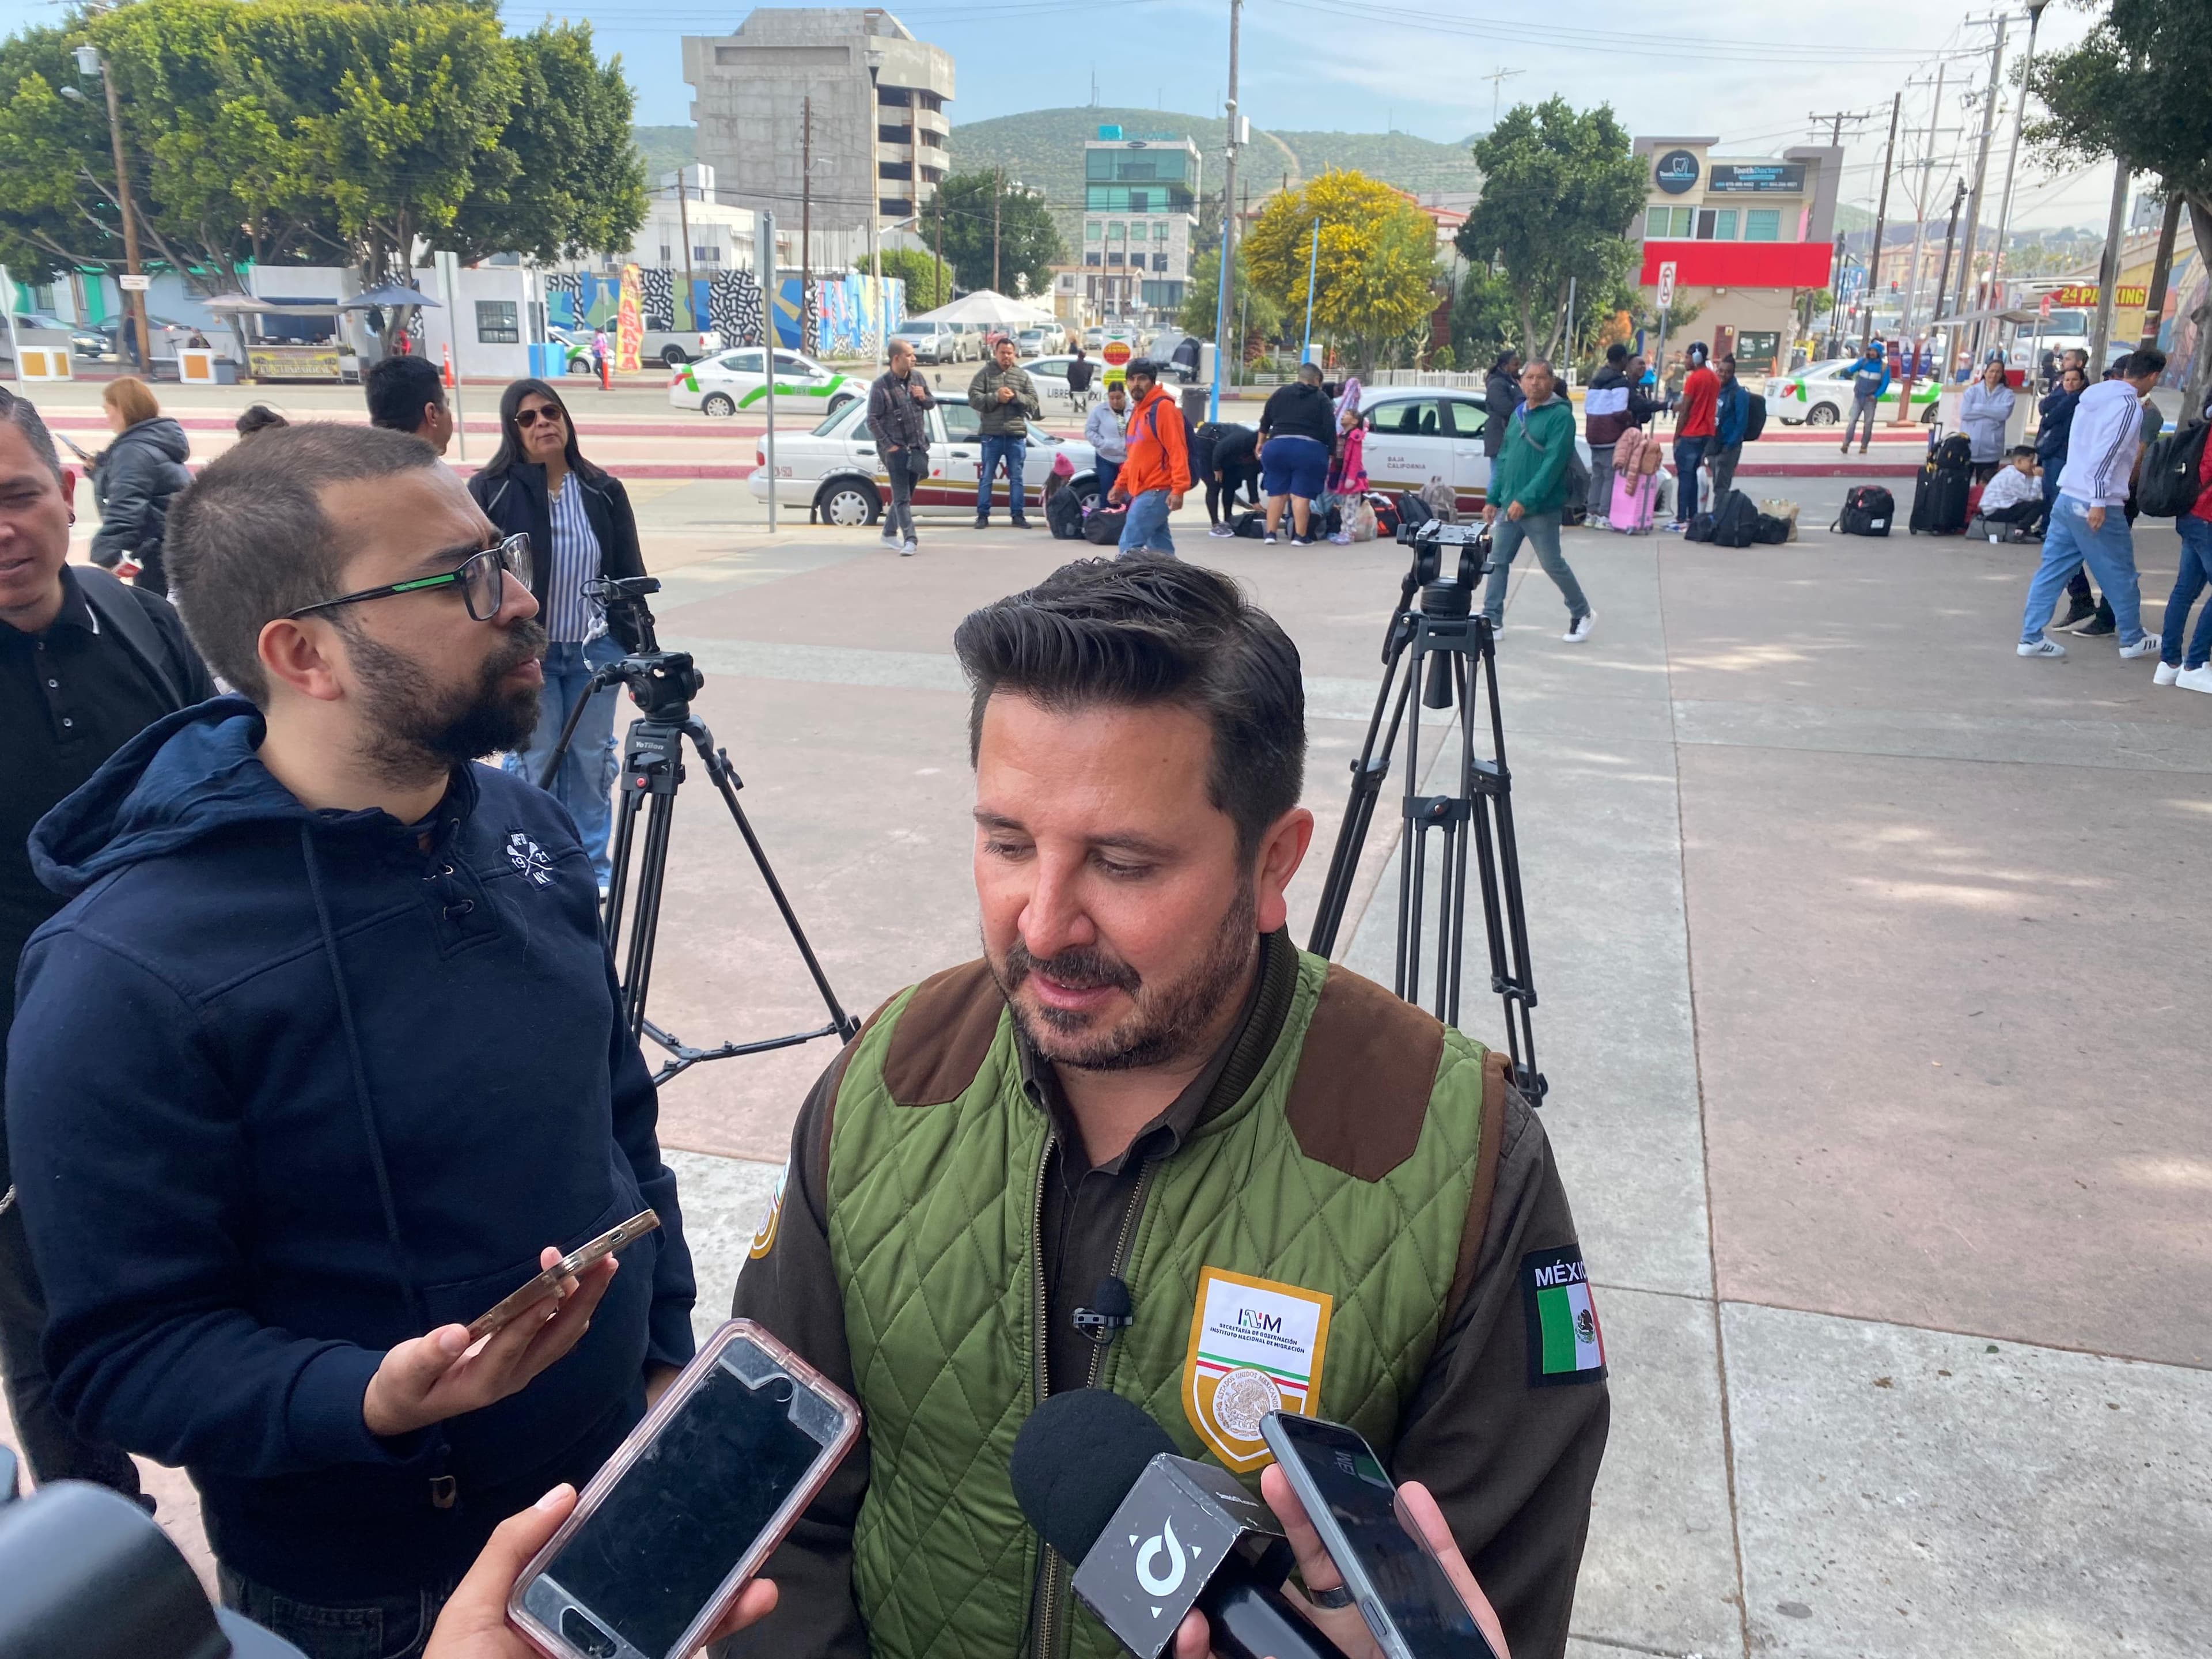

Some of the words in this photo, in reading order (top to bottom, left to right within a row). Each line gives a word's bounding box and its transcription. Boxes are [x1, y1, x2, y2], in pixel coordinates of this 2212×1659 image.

[2062, 287, 2077, 298] 24
[2080, 287, 2145, 304] PAKING
[1047, 388, 1069, 399] LIBRE
[1210, 1327, 1237, 1338] INSTITUTO
[1238, 1334, 1265, 1344] NACIONAL
[1274, 1342, 1305, 1354] MIGRACIÓN
[1219, 1323, 1251, 1335] SECRETARÍA
[1259, 1332, 1298, 1346] GOBERNACIÓN
[1217, 1376, 1235, 1400] ESTADOS
[1235, 1371, 1257, 1379] UNIDOS
[1258, 1376, 1279, 1408] MEXICANOS
